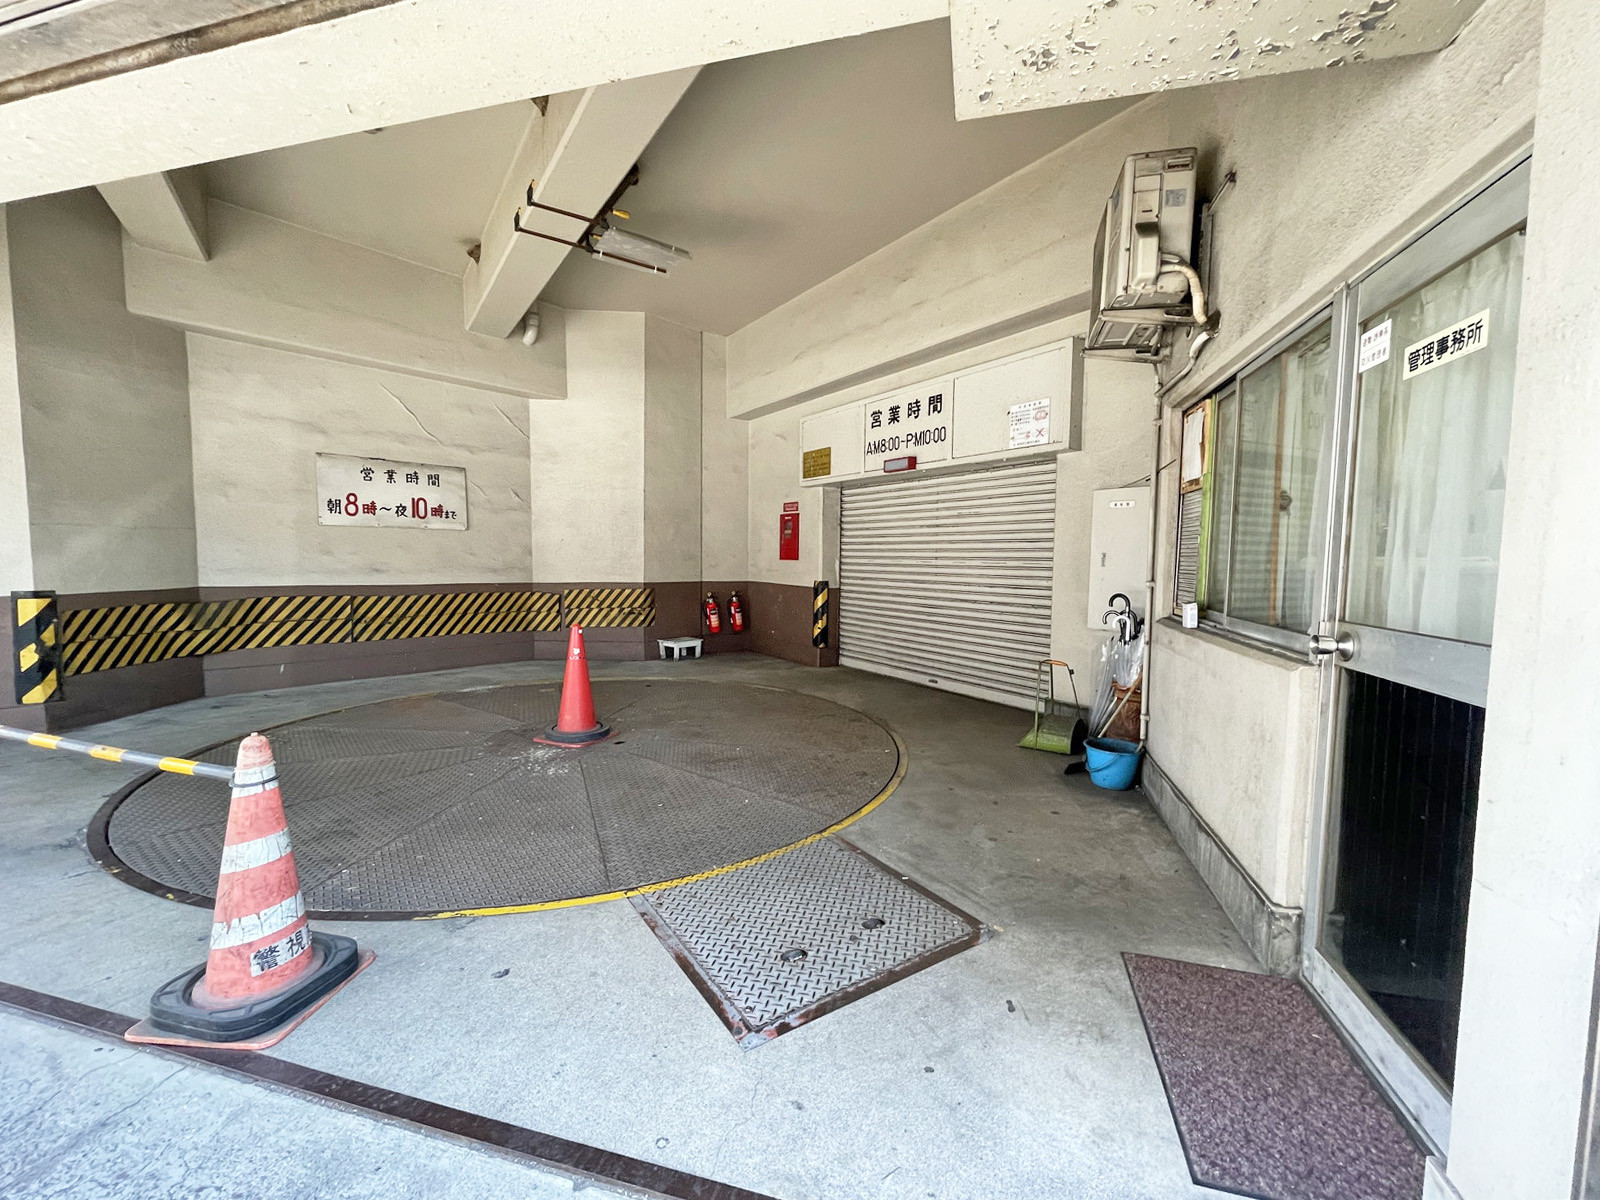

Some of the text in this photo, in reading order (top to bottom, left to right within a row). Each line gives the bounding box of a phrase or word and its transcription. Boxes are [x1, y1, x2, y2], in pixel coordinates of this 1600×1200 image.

[1408, 318, 1484, 372] 管理事務所
[870, 393, 943, 429] 営業時間
[360, 466, 440, 488] 営業時間
